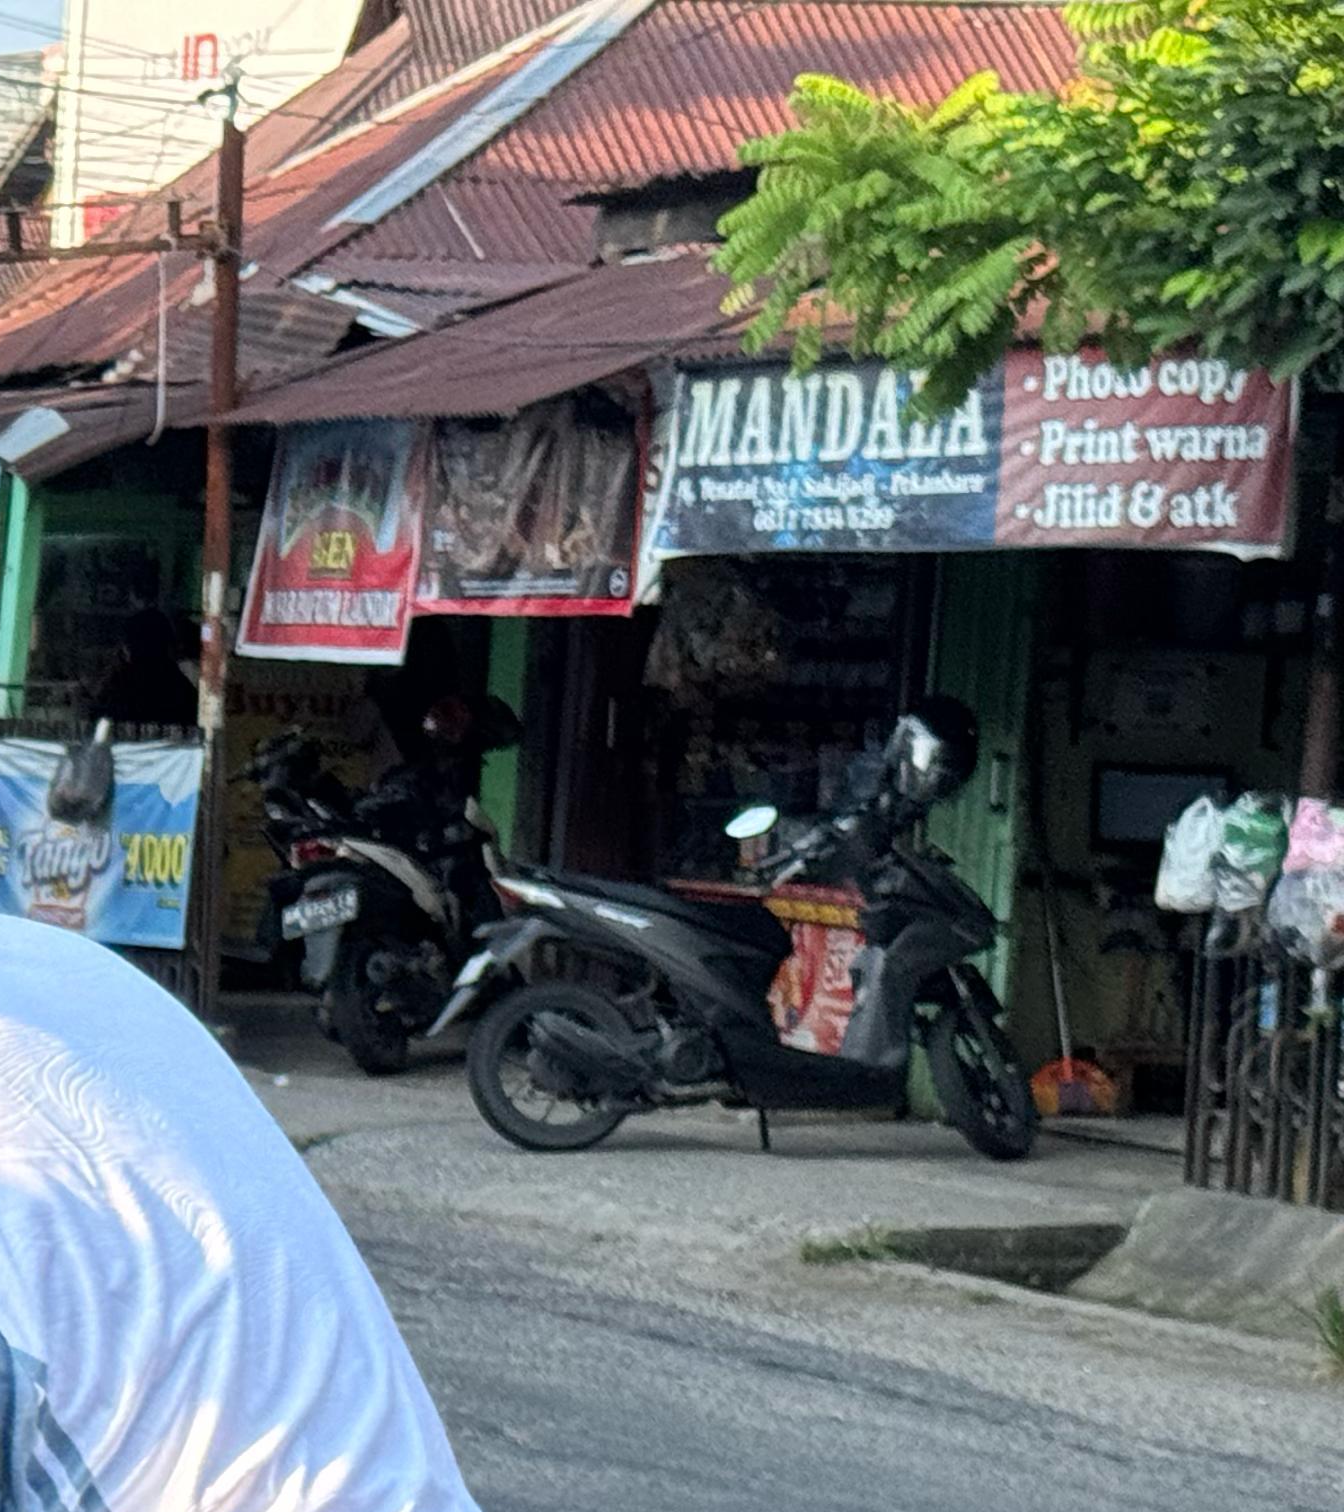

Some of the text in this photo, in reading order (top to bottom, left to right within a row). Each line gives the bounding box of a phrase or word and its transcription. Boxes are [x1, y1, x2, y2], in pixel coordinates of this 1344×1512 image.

[1039, 418, 1269, 466] Print warna
[1033, 481, 1240, 529] Jilid & atk
[16, 830, 112, 892] Tango
